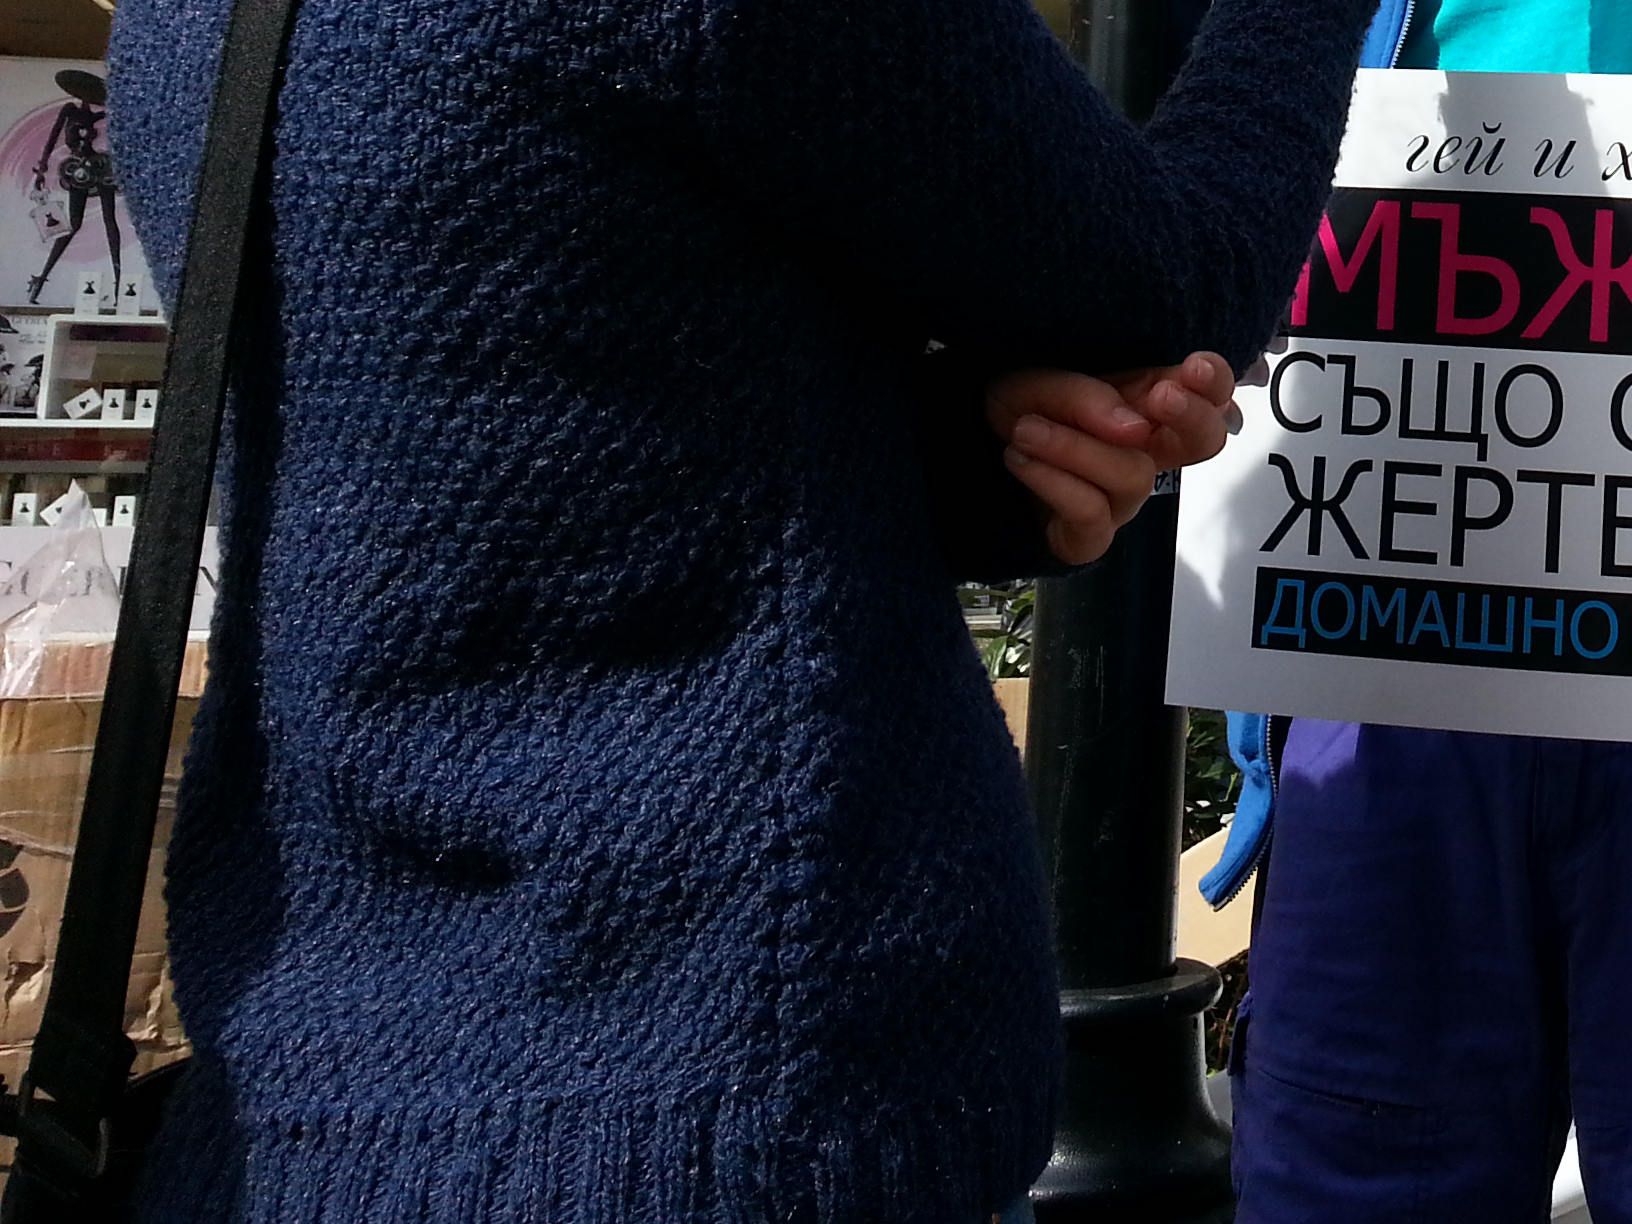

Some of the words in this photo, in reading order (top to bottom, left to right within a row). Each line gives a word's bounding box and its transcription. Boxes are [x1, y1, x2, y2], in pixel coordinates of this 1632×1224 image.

[1406, 121, 1506, 178] гей
[1531, 138, 1576, 181] и
[1268, 351, 1565, 458] СЪЩО
[1261, 579, 1620, 662] ДОМАШНО
